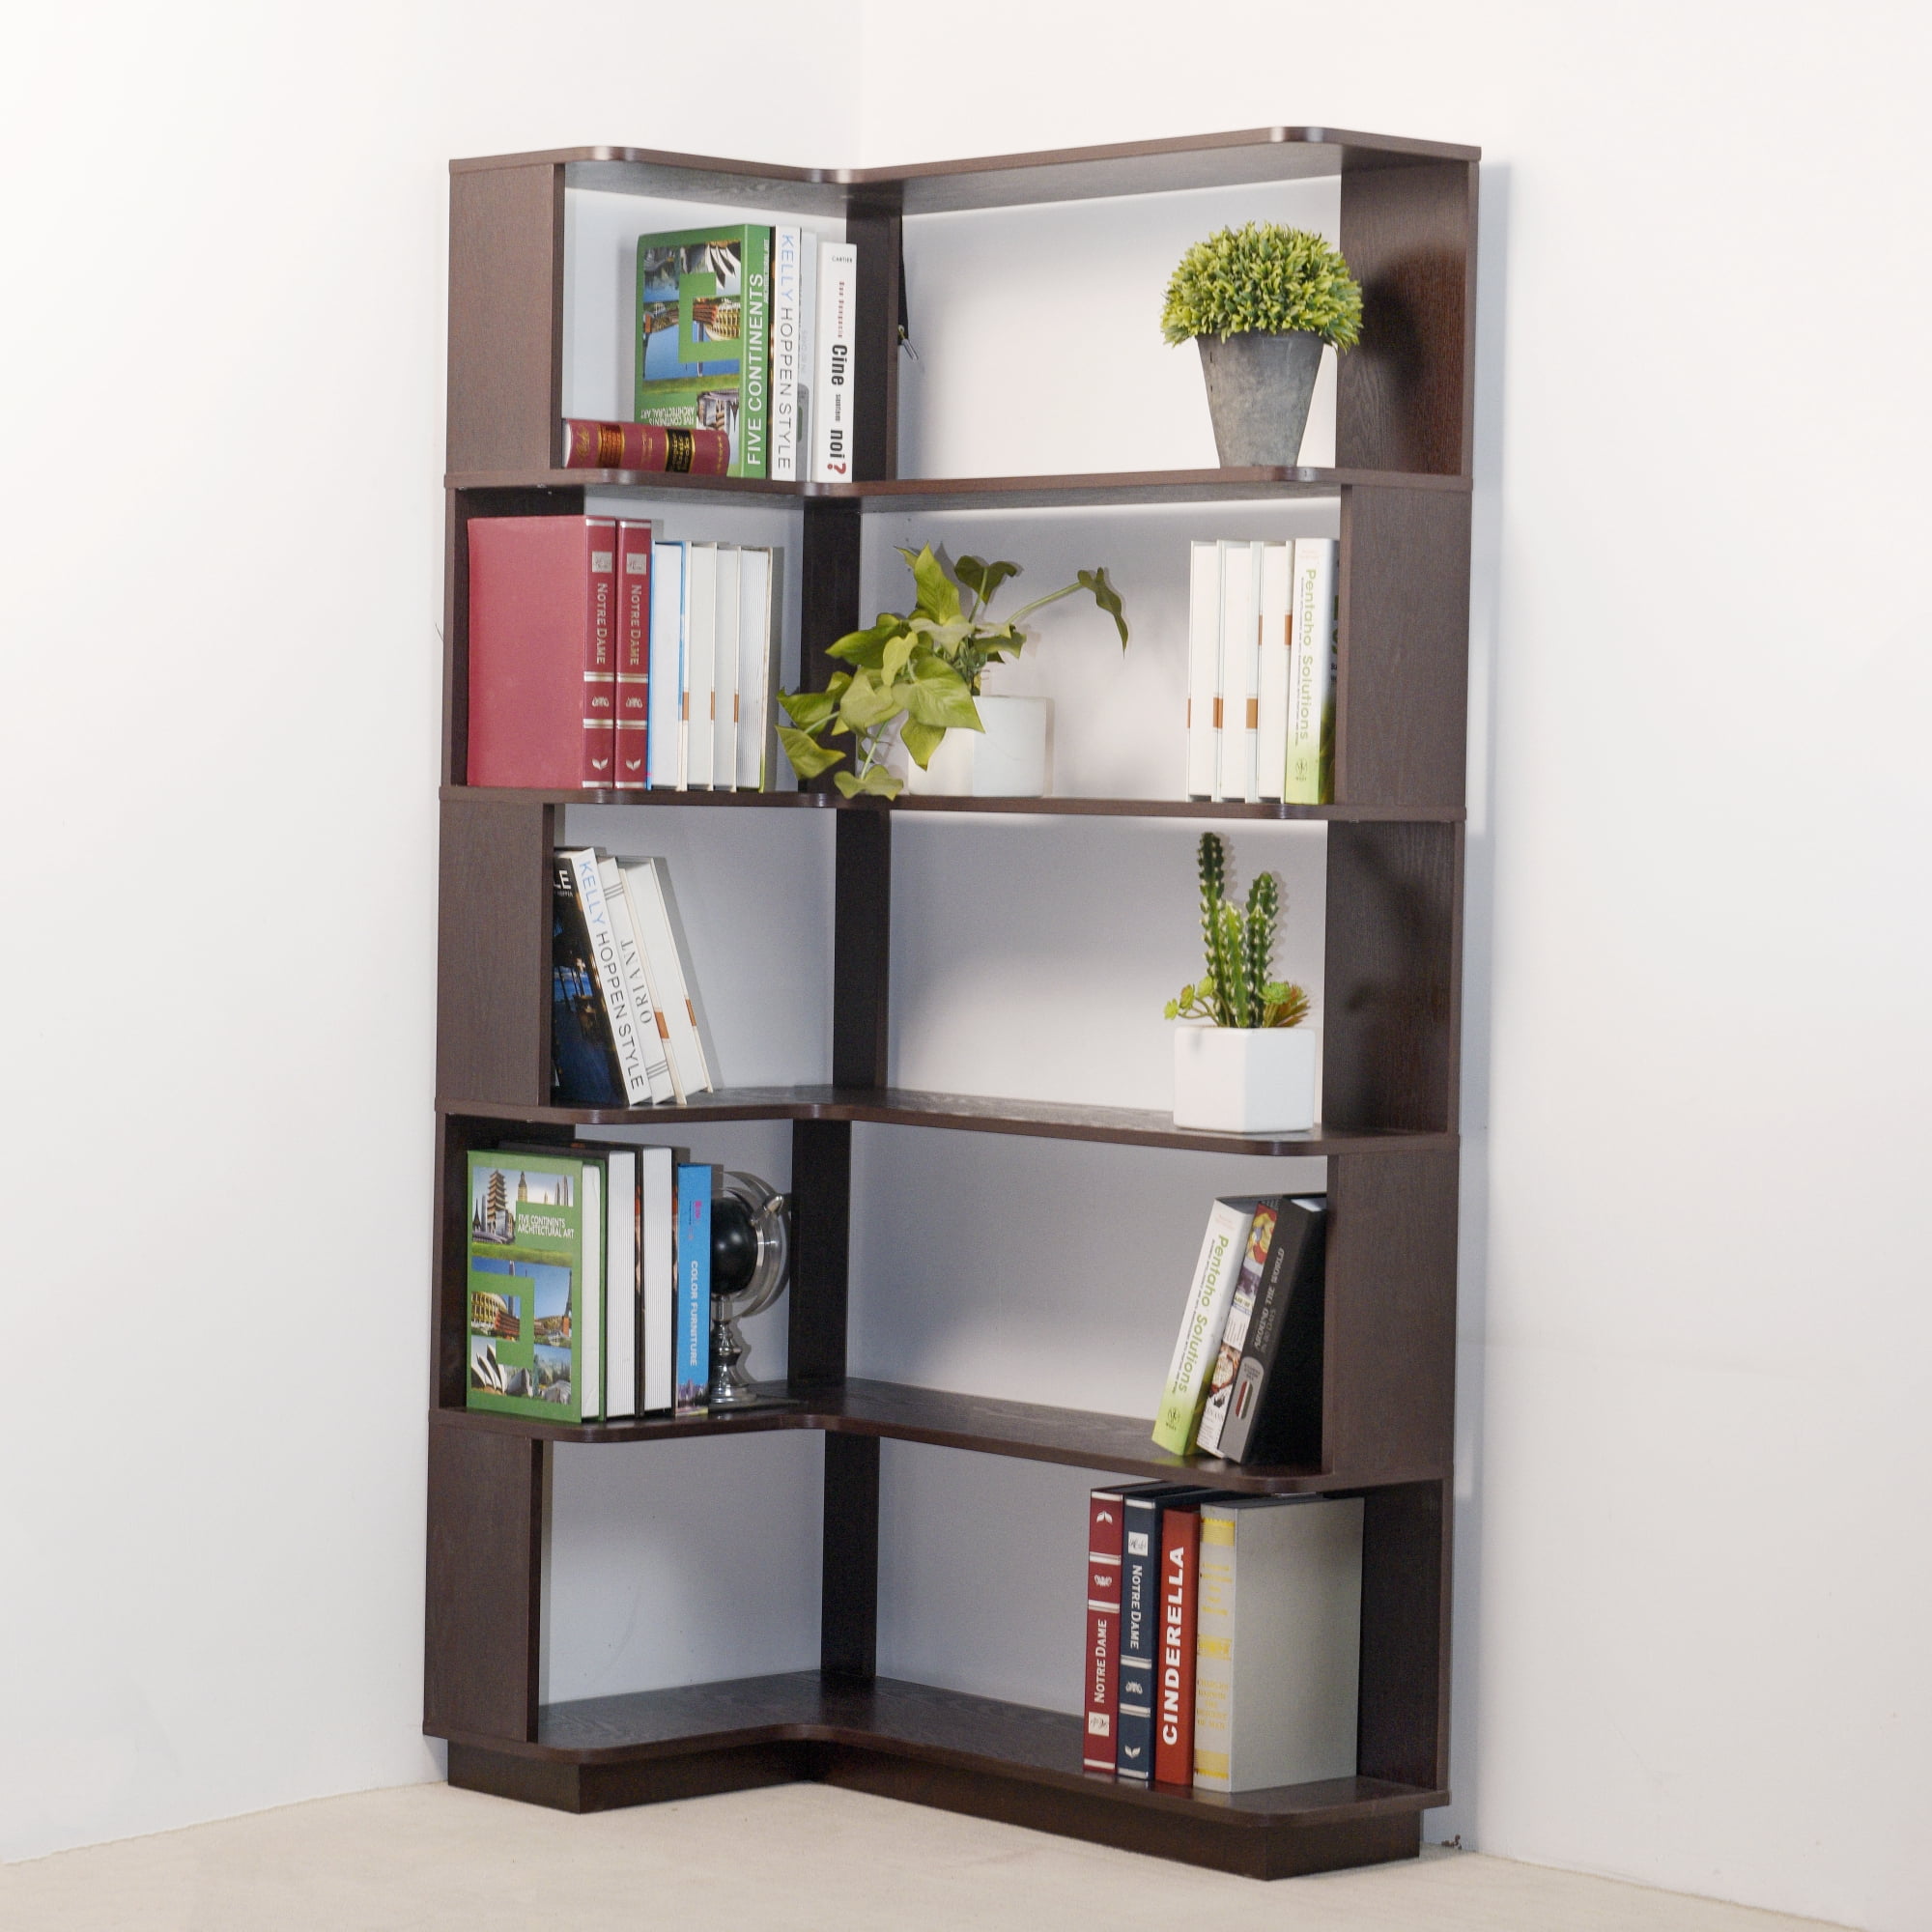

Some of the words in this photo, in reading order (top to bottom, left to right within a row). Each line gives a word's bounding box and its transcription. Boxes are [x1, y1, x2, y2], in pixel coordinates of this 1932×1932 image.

[781, 234, 795, 302] KELLY
[748, 272, 764, 413] CONTINENTS
[778, 307, 793, 397] HOPPEN
[831, 344, 847, 385] Cine
[747, 415, 761, 466] FIVE
[777, 402, 792, 469] STYLE
[596, 582, 608, 626] NOTRE
[630, 583, 642, 627] NOTRE
[1303, 568, 1317, 647] Pentaho
[596, 628, 608, 666] DAME
[629, 629, 641, 667] DAME
[1299, 654, 1314, 741] Solutions
[580, 860, 606, 925] KELLY
[596, 930, 627, 1020] HOPPEN
[618, 1022, 644, 1091] STYLE
[517, 1224, 563, 1237] ARCHITECTURAL
[563, 1228, 575, 1239] ART
[518, 1213, 529, 1225] FIVE
[530, 1215, 566, 1229] CONTINENTS
[690, 1260, 698, 1299] COLOR
[1202, 1234, 1230, 1308] Pentaho
[1264, 1282, 1276, 1305] THE
[690, 1300, 698, 1367] FURNITURE
[1178, 1314, 1208, 1394] Solutions
[1131, 1564, 1143, 1610] NOTRE
[1094, 1619, 1107, 1657] DAME
[1129, 1611, 1142, 1651] DAME
[1162, 1547, 1184, 1746] CINDERELLA
[1094, 1658, 1106, 1704] NOTRE
